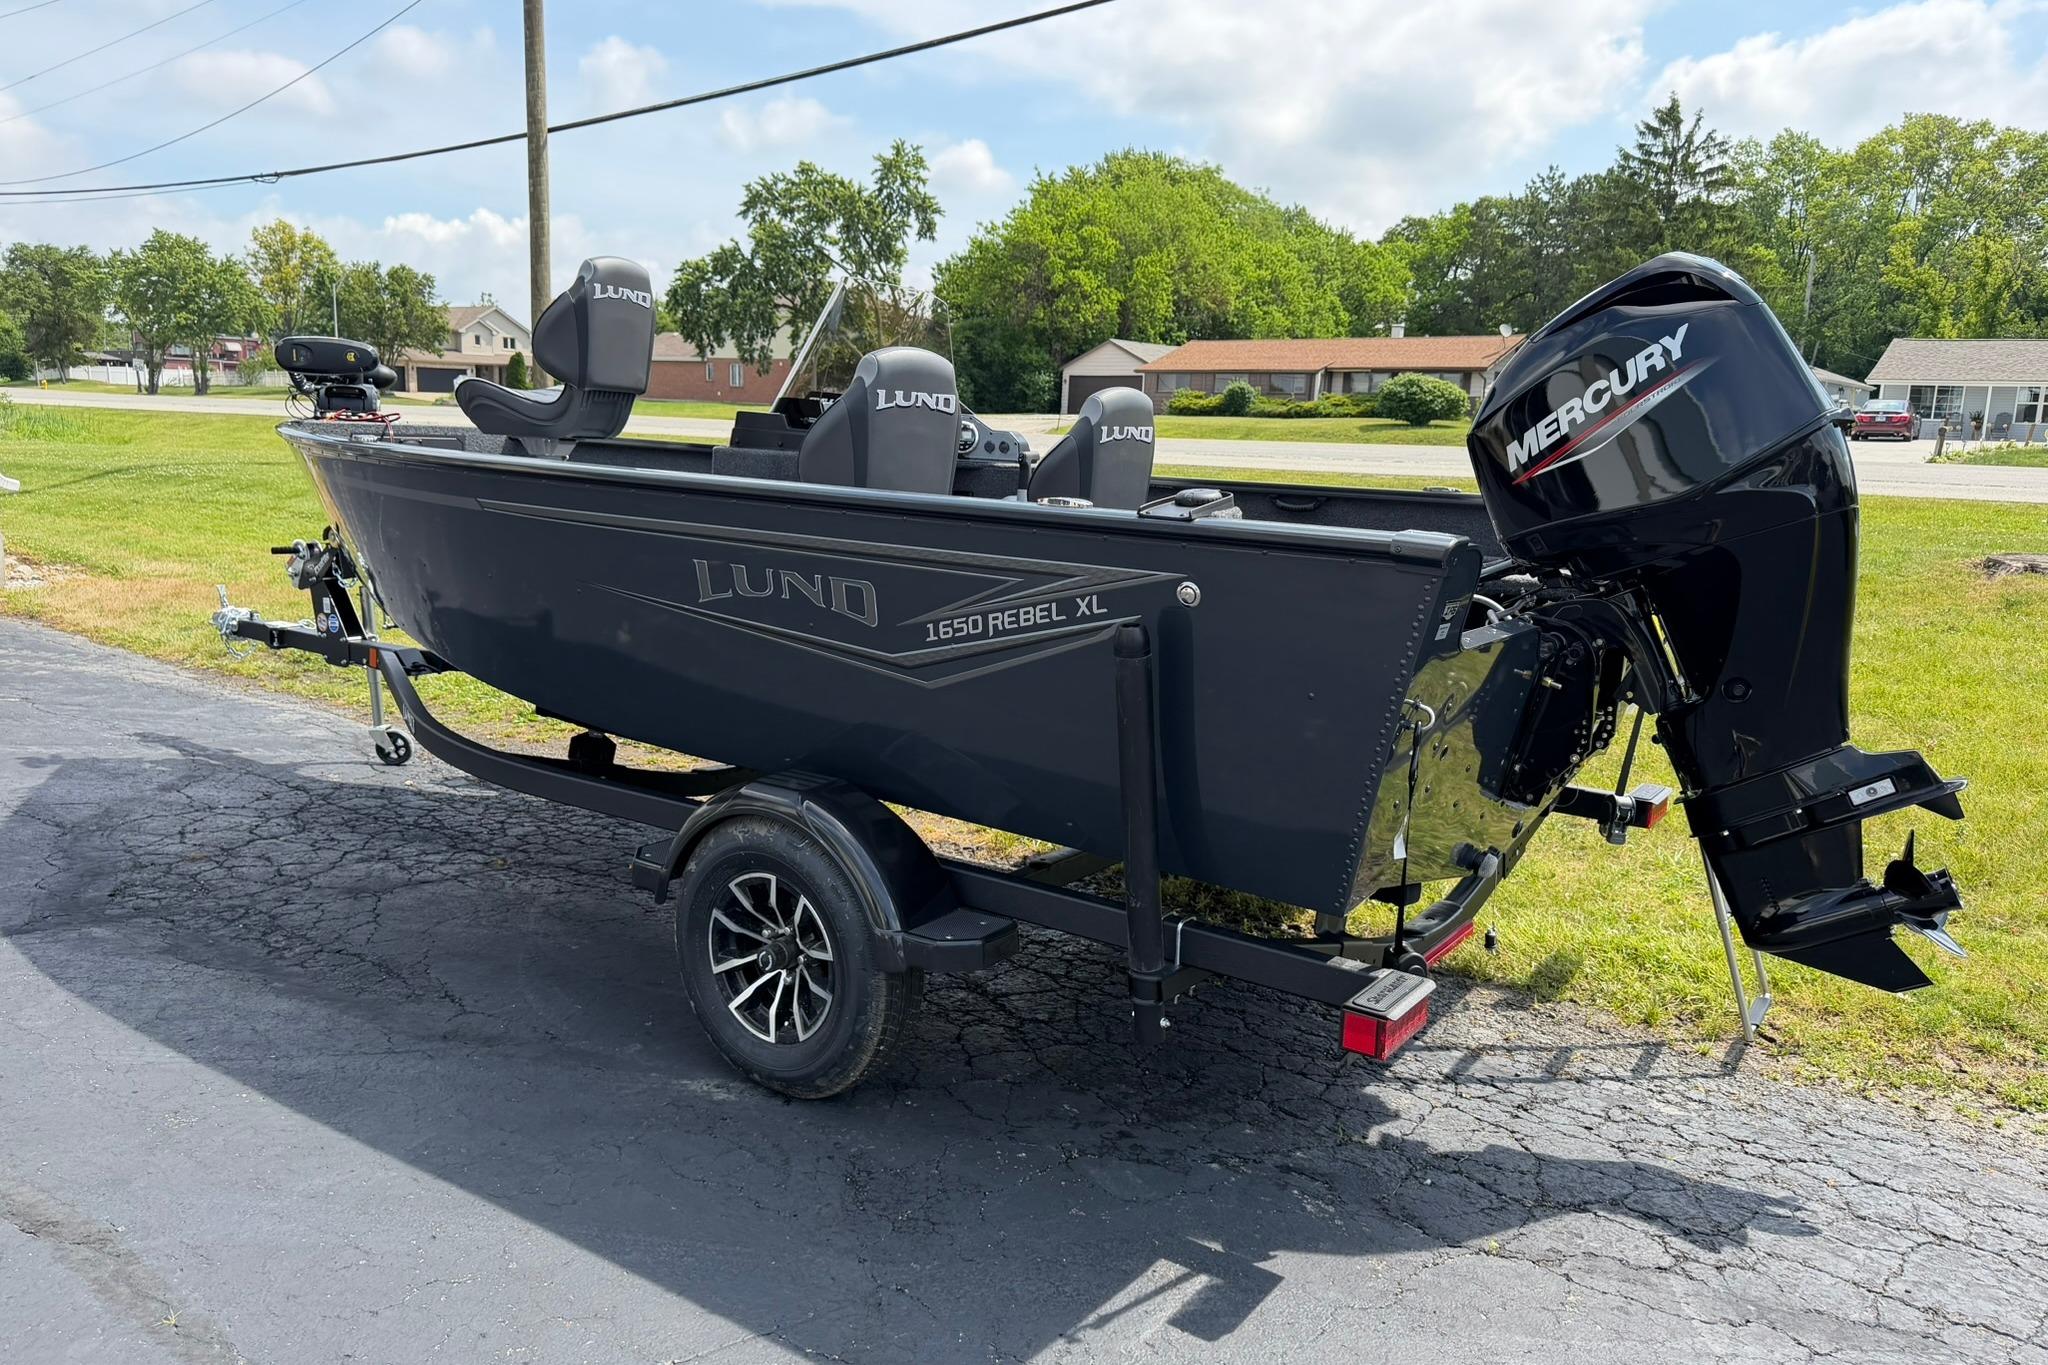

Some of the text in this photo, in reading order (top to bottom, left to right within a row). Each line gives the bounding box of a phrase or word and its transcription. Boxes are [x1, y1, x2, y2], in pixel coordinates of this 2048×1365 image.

[593, 282, 652, 309] LUND
[876, 389, 956, 414] LUND
[1505, 322, 1689, 473] MERCURY
[1099, 425, 1154, 444] LUND
[692, 558, 878, 628] LUND
[925, 594, 1108, 642] 1650 REBEL XL
